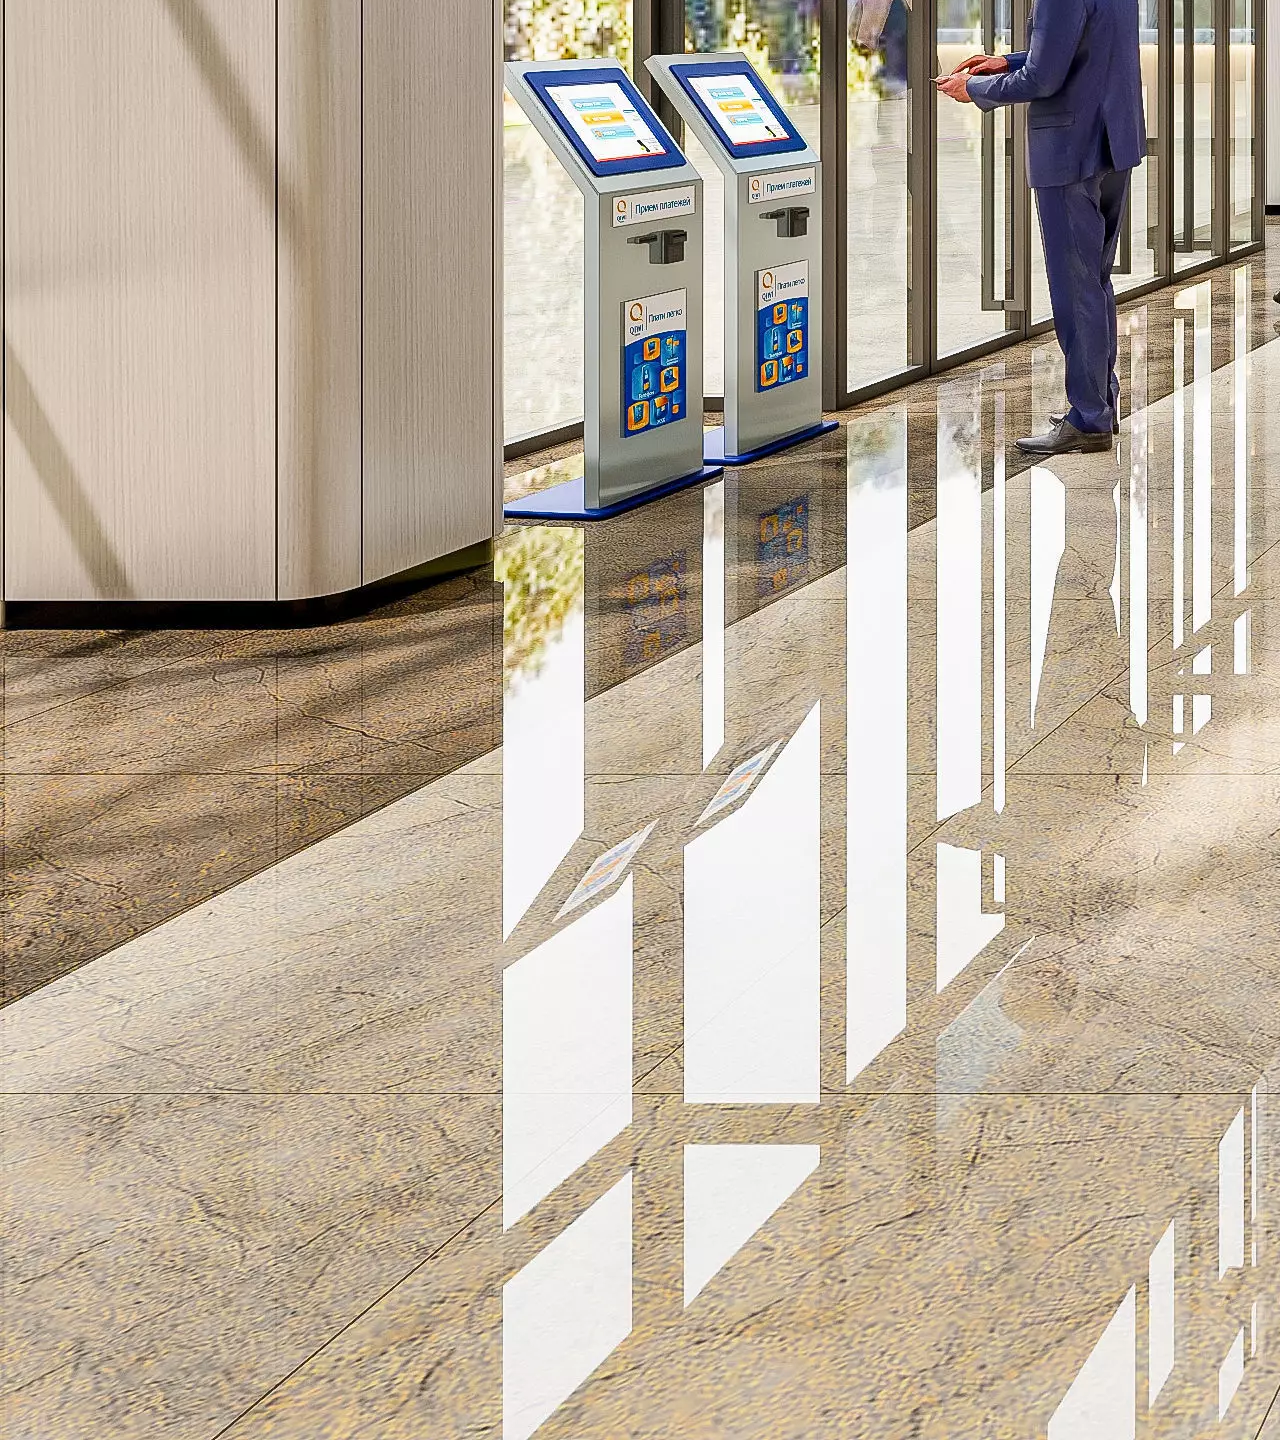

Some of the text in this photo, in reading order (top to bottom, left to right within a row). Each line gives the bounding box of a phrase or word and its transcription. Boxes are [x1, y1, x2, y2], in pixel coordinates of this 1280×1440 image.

[766, 177, 812, 193] Прием платежей
[635, 196, 691, 215] Прием платежей
